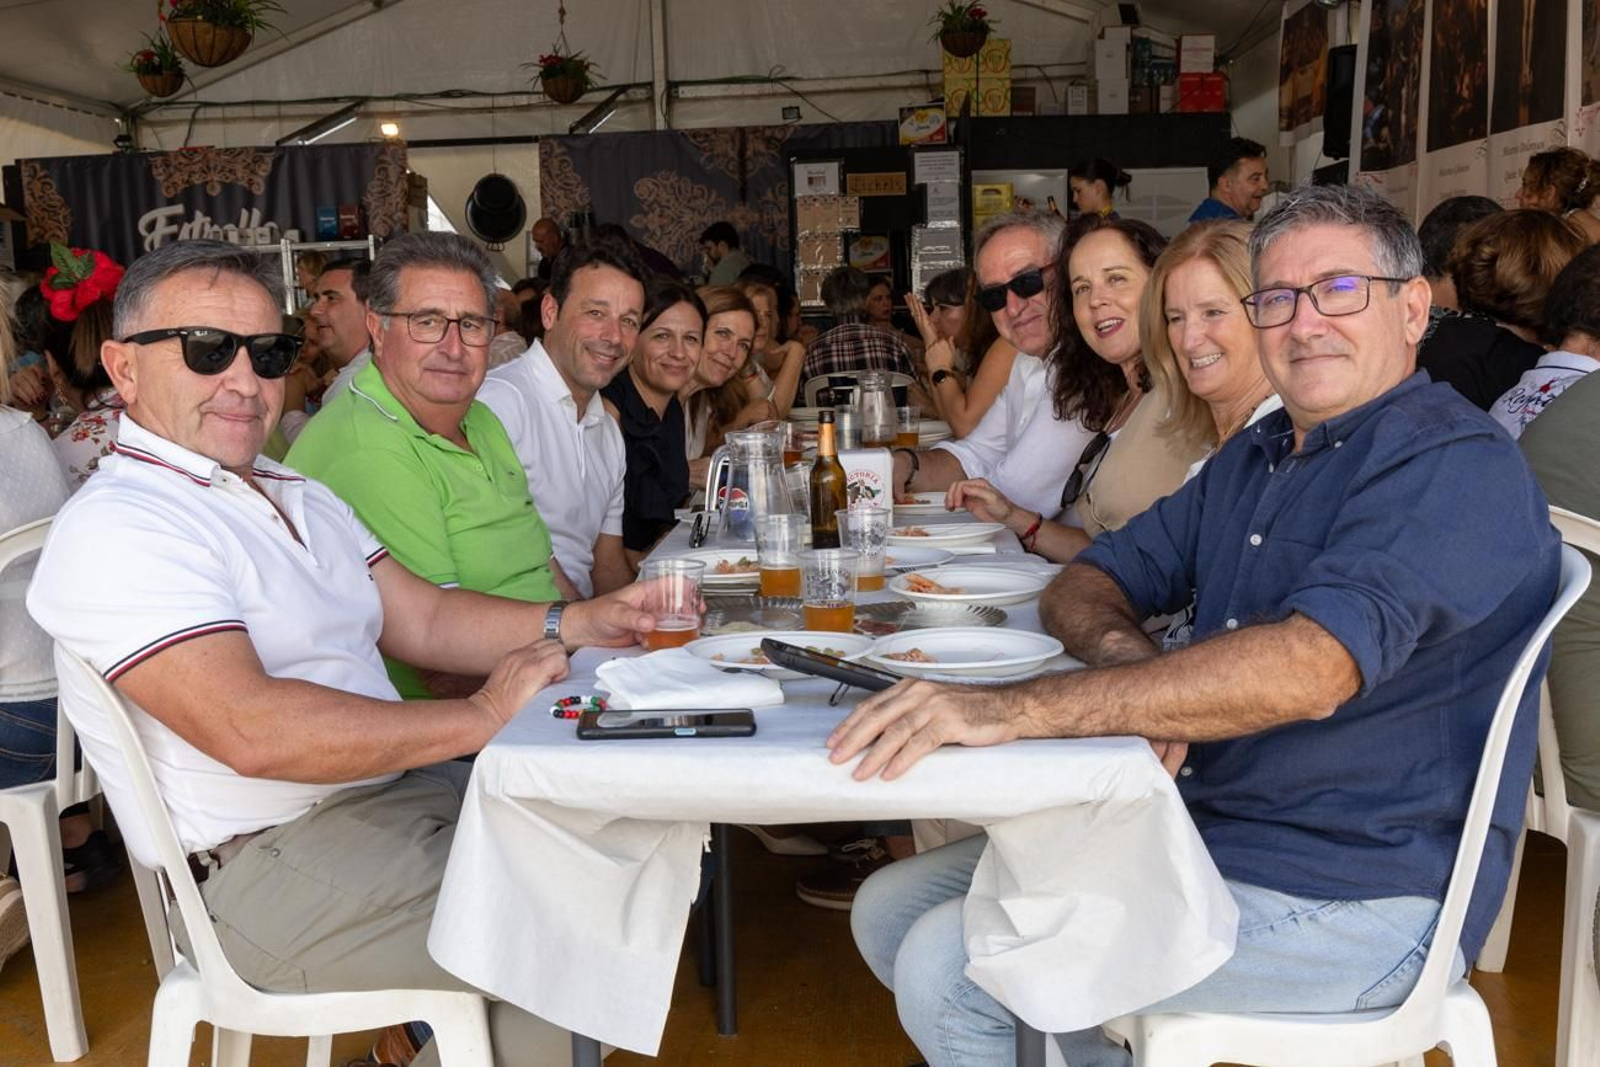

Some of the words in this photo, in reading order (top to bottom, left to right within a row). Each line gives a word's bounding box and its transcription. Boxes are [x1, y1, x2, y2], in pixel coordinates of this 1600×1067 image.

[138, 203, 278, 252] Estrll
[847, 471, 879, 486] ICTORIA
[719, 498, 748, 509] PPSI
